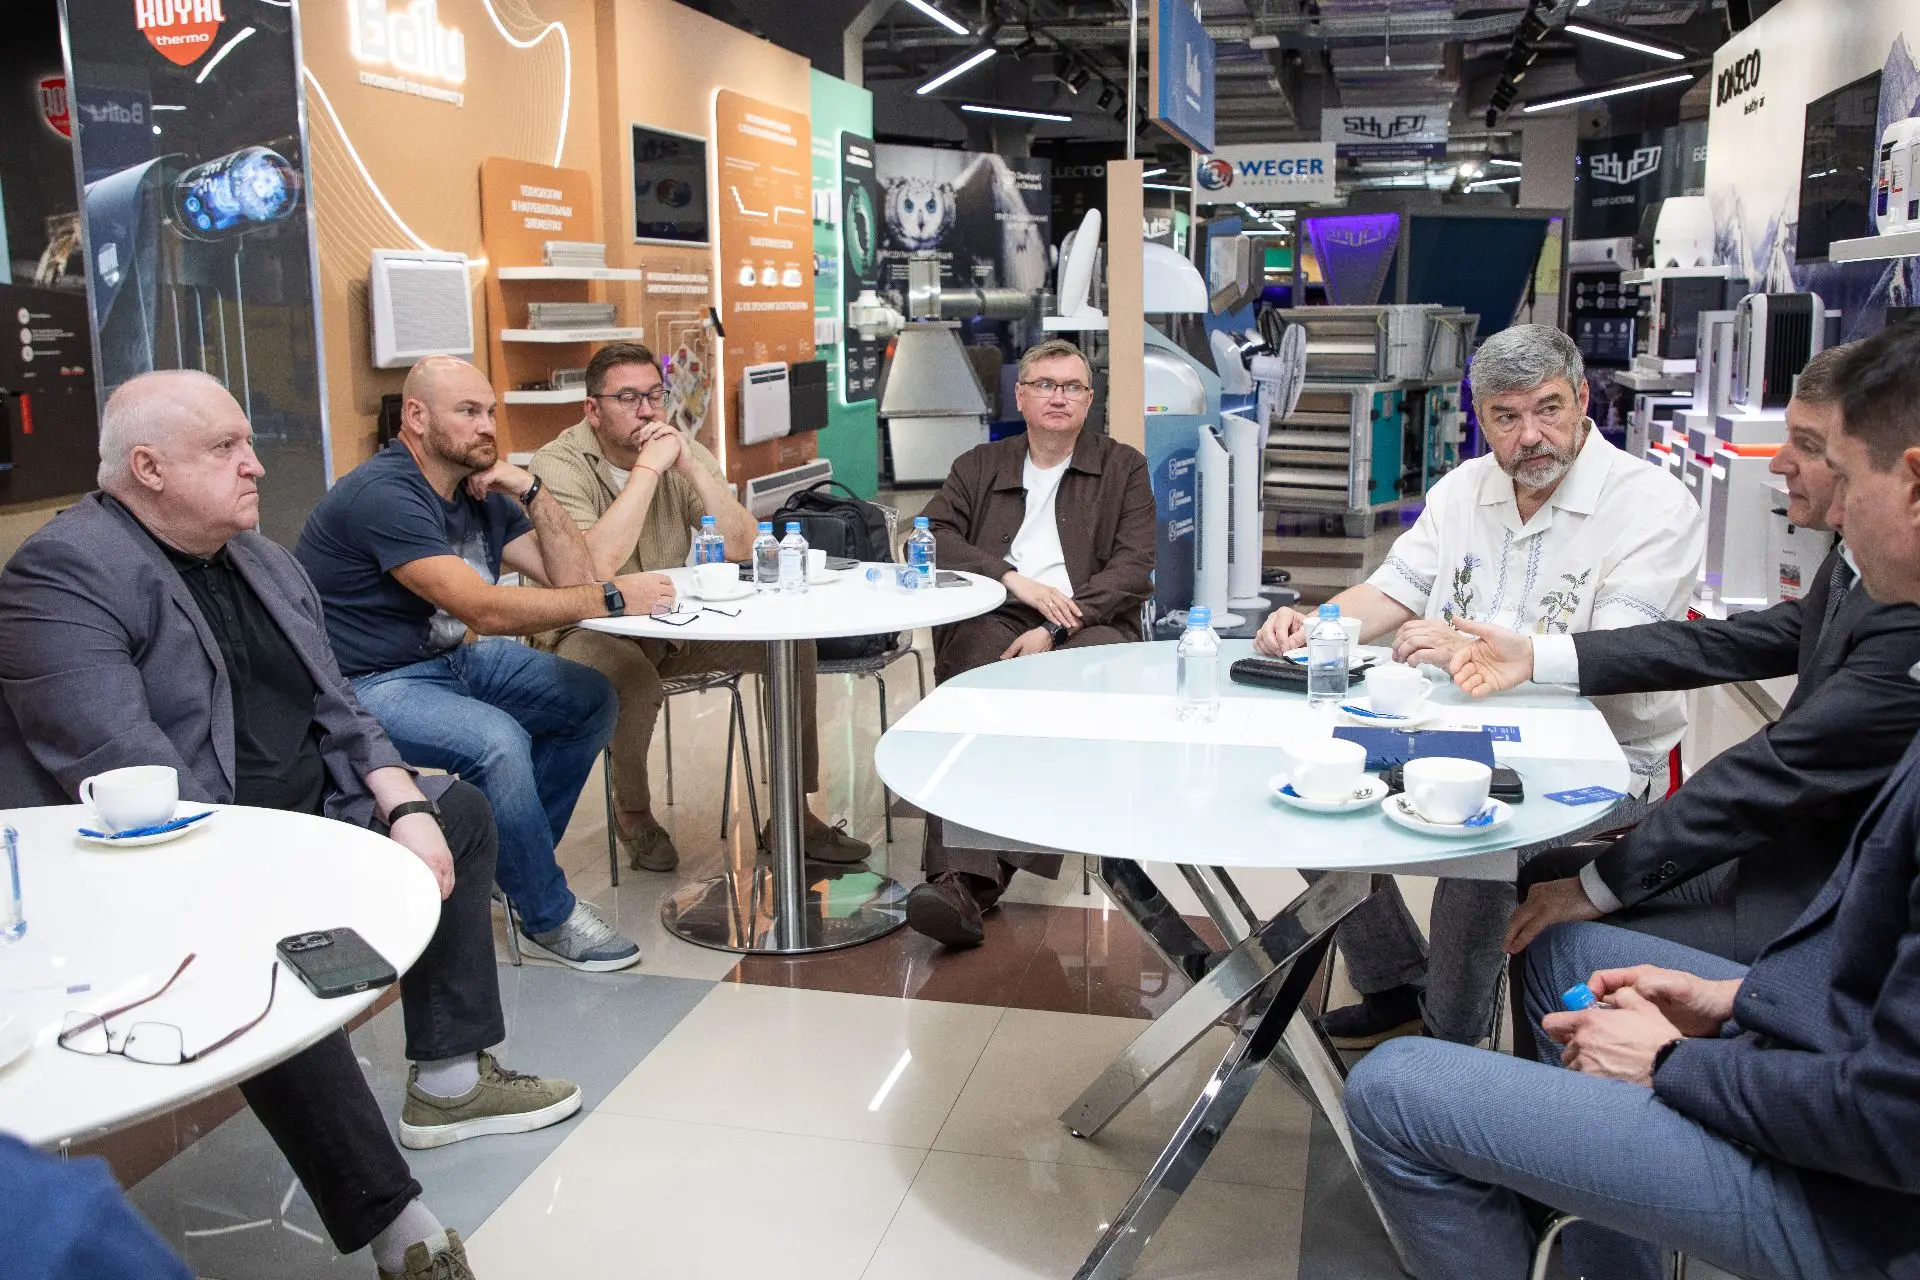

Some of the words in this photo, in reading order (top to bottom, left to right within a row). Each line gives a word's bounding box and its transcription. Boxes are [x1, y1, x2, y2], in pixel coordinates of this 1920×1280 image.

[156, 33, 209, 46] thermo
[1343, 114, 1426, 139] SHUFT
[1238, 159, 1324, 176] WEGER
[1589, 146, 1662, 185] SHUFT
